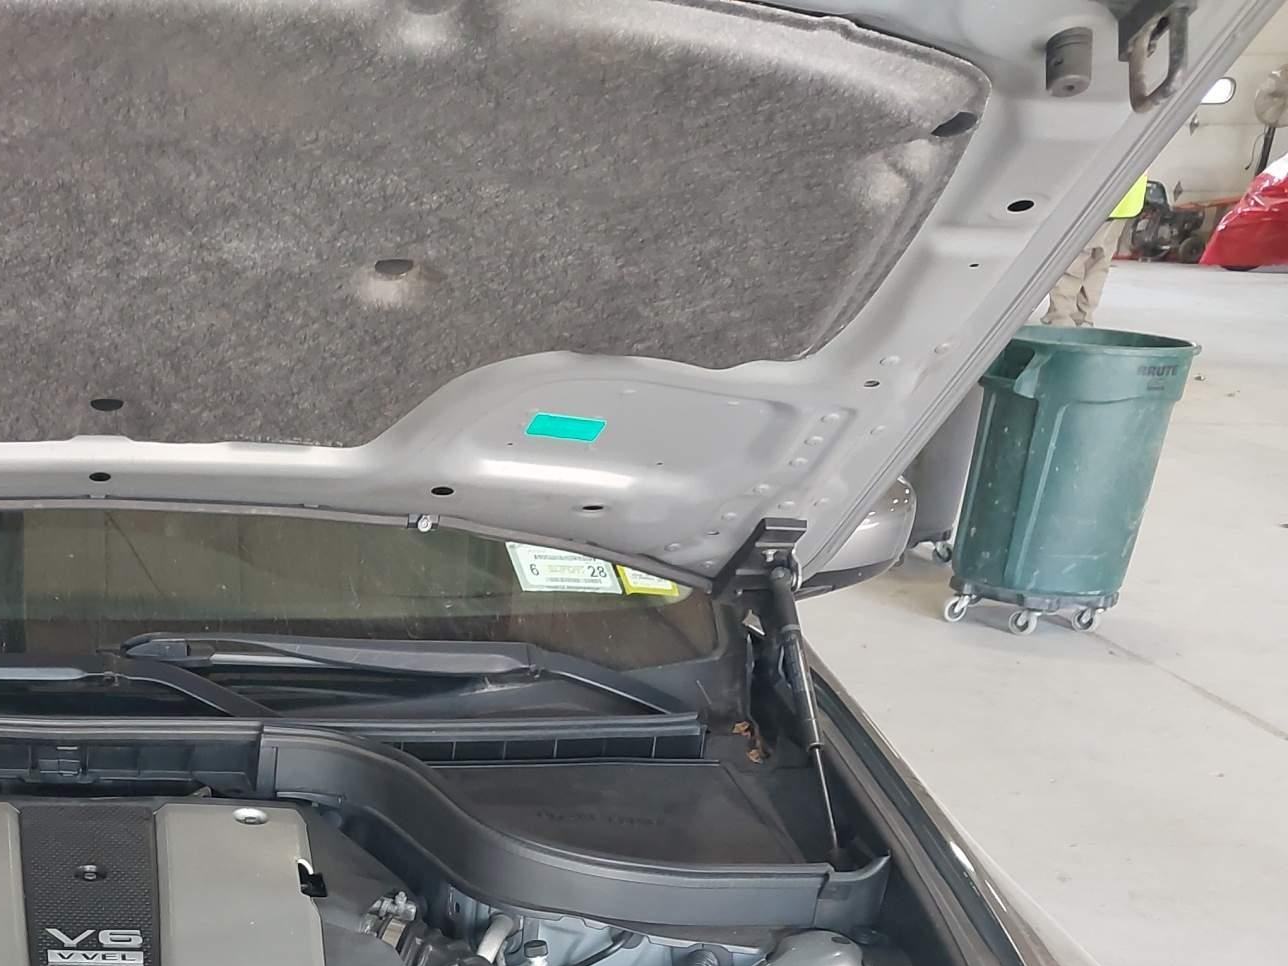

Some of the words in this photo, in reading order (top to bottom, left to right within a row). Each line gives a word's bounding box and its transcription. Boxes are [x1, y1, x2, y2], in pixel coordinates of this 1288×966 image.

[529, 563, 540, 576] 6
[587, 565, 608, 578] 28
[45, 928, 143, 948] V6
[57, 952, 137, 961] VVEL
